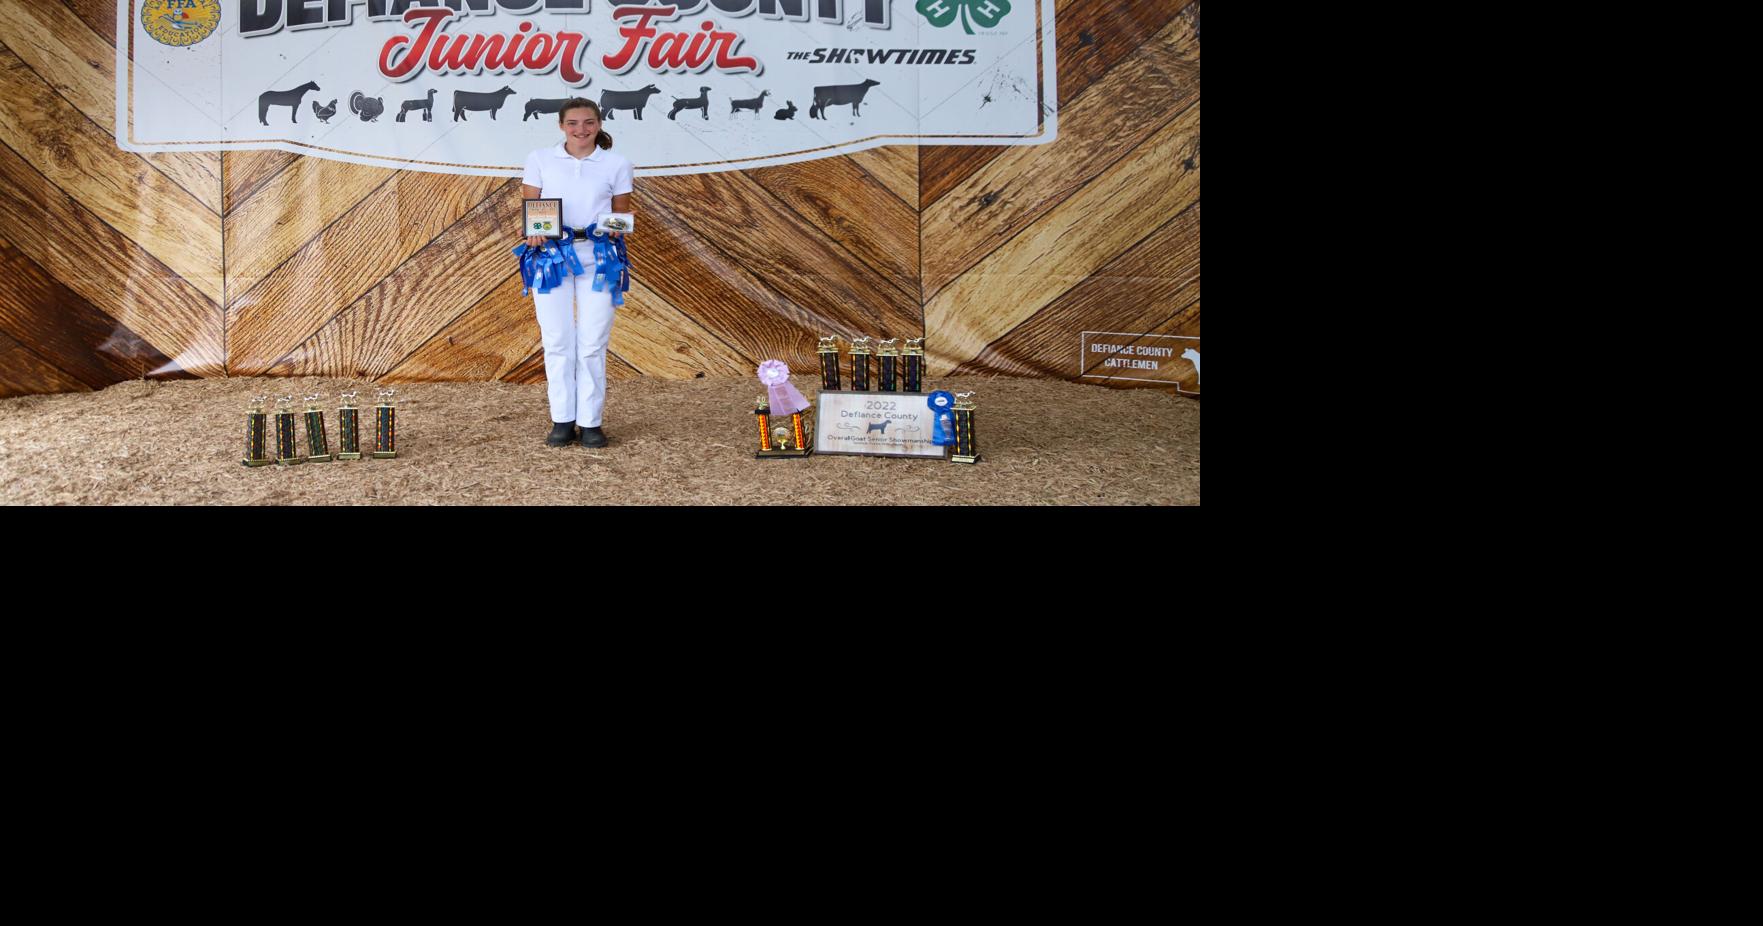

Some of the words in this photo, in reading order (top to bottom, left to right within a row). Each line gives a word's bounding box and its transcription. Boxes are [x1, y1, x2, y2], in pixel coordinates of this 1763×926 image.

[167, 0, 197, 8] FFA
[377, 6, 586, 84] Junior
[601, 5, 758, 72] Fair
[786, 51, 812, 60] THE
[1091, 343, 1135, 355] DEFIANCE
[1136, 346, 1173, 357] COUNTY
[1104, 358, 1158, 370] CATTLEMEN
[866, 400, 897, 411] 2022
[884, 411, 918, 421] County
